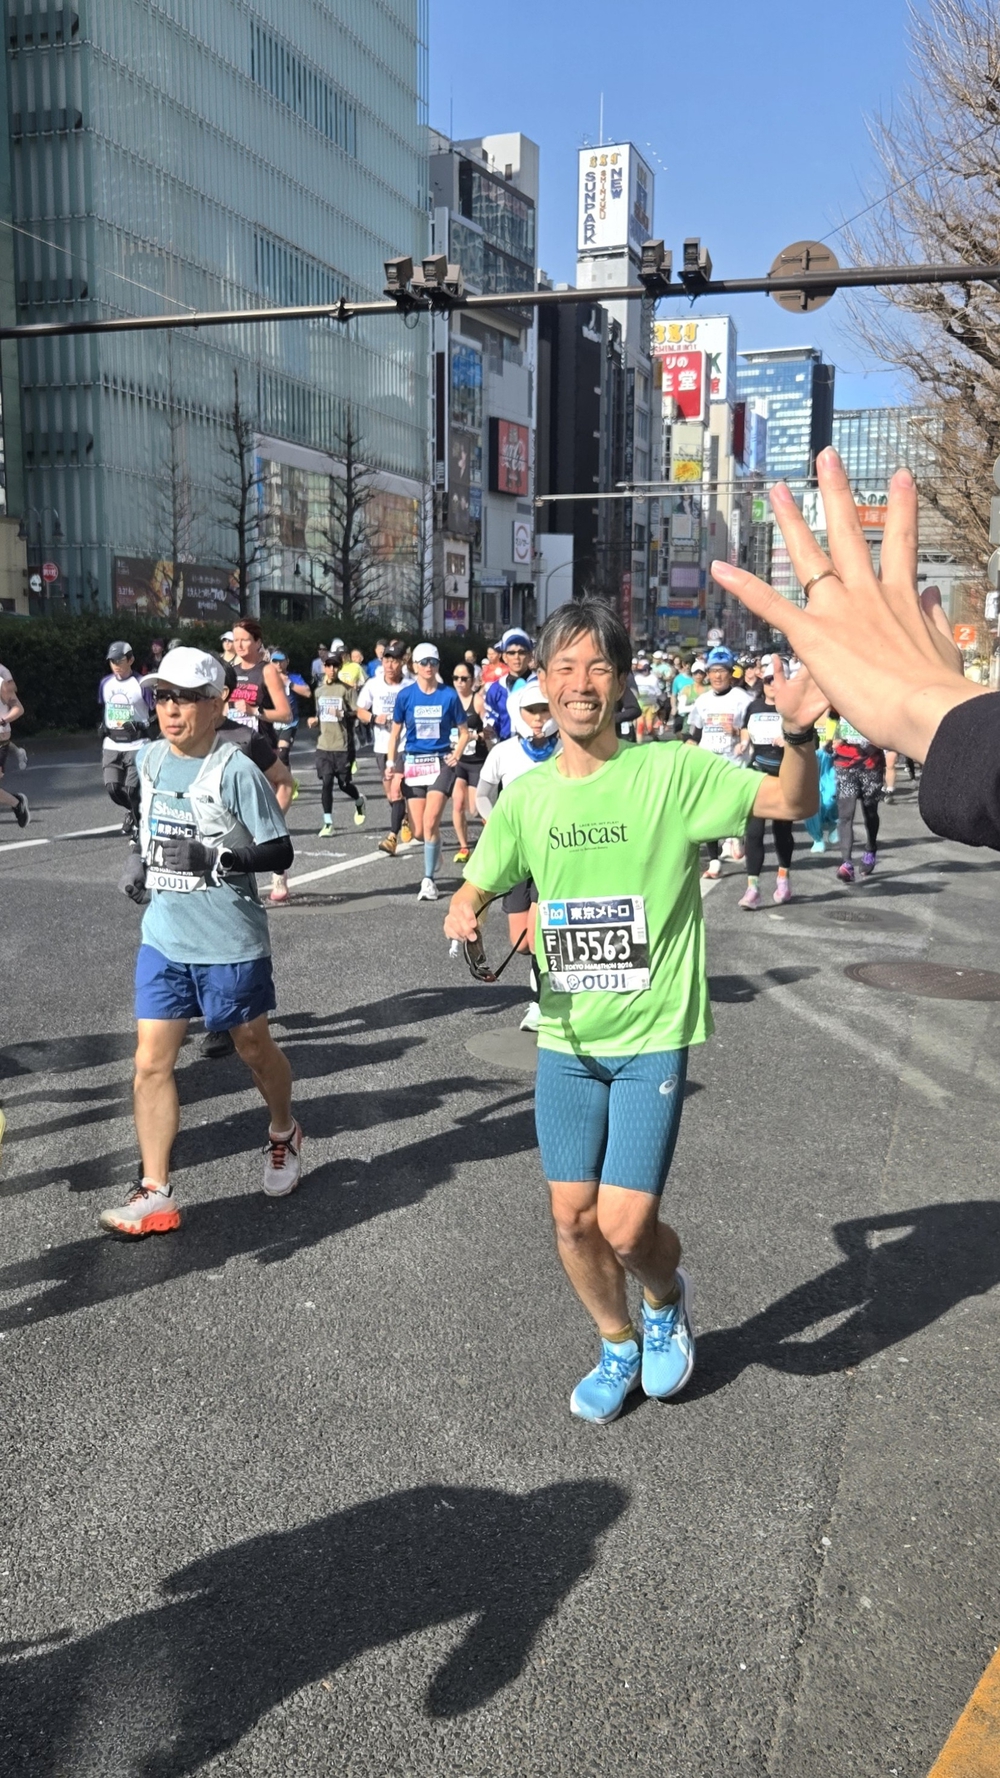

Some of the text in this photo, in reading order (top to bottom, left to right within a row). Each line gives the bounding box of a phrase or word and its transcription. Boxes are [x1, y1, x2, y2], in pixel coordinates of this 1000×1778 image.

[610, 167, 623, 199] NEW
[583, 171, 597, 245] SUNPARK
[665, 355, 689, 370] りの
[958, 627, 971, 640] 2
[157, 823, 193, 838] 東京メトロ
[549, 822, 629, 850] Subcast
[158, 875, 189, 890] OUJI
[570, 904, 630, 920] 東京メトロ
[545, 934, 557, 952] F
[565, 929, 631, 962] 15563
[549, 959, 558, 971] 2
[565, 963, 584, 971] TOKYO
[584, 962, 617, 970] MARATHON
[583, 973, 626, 989] OUJI
